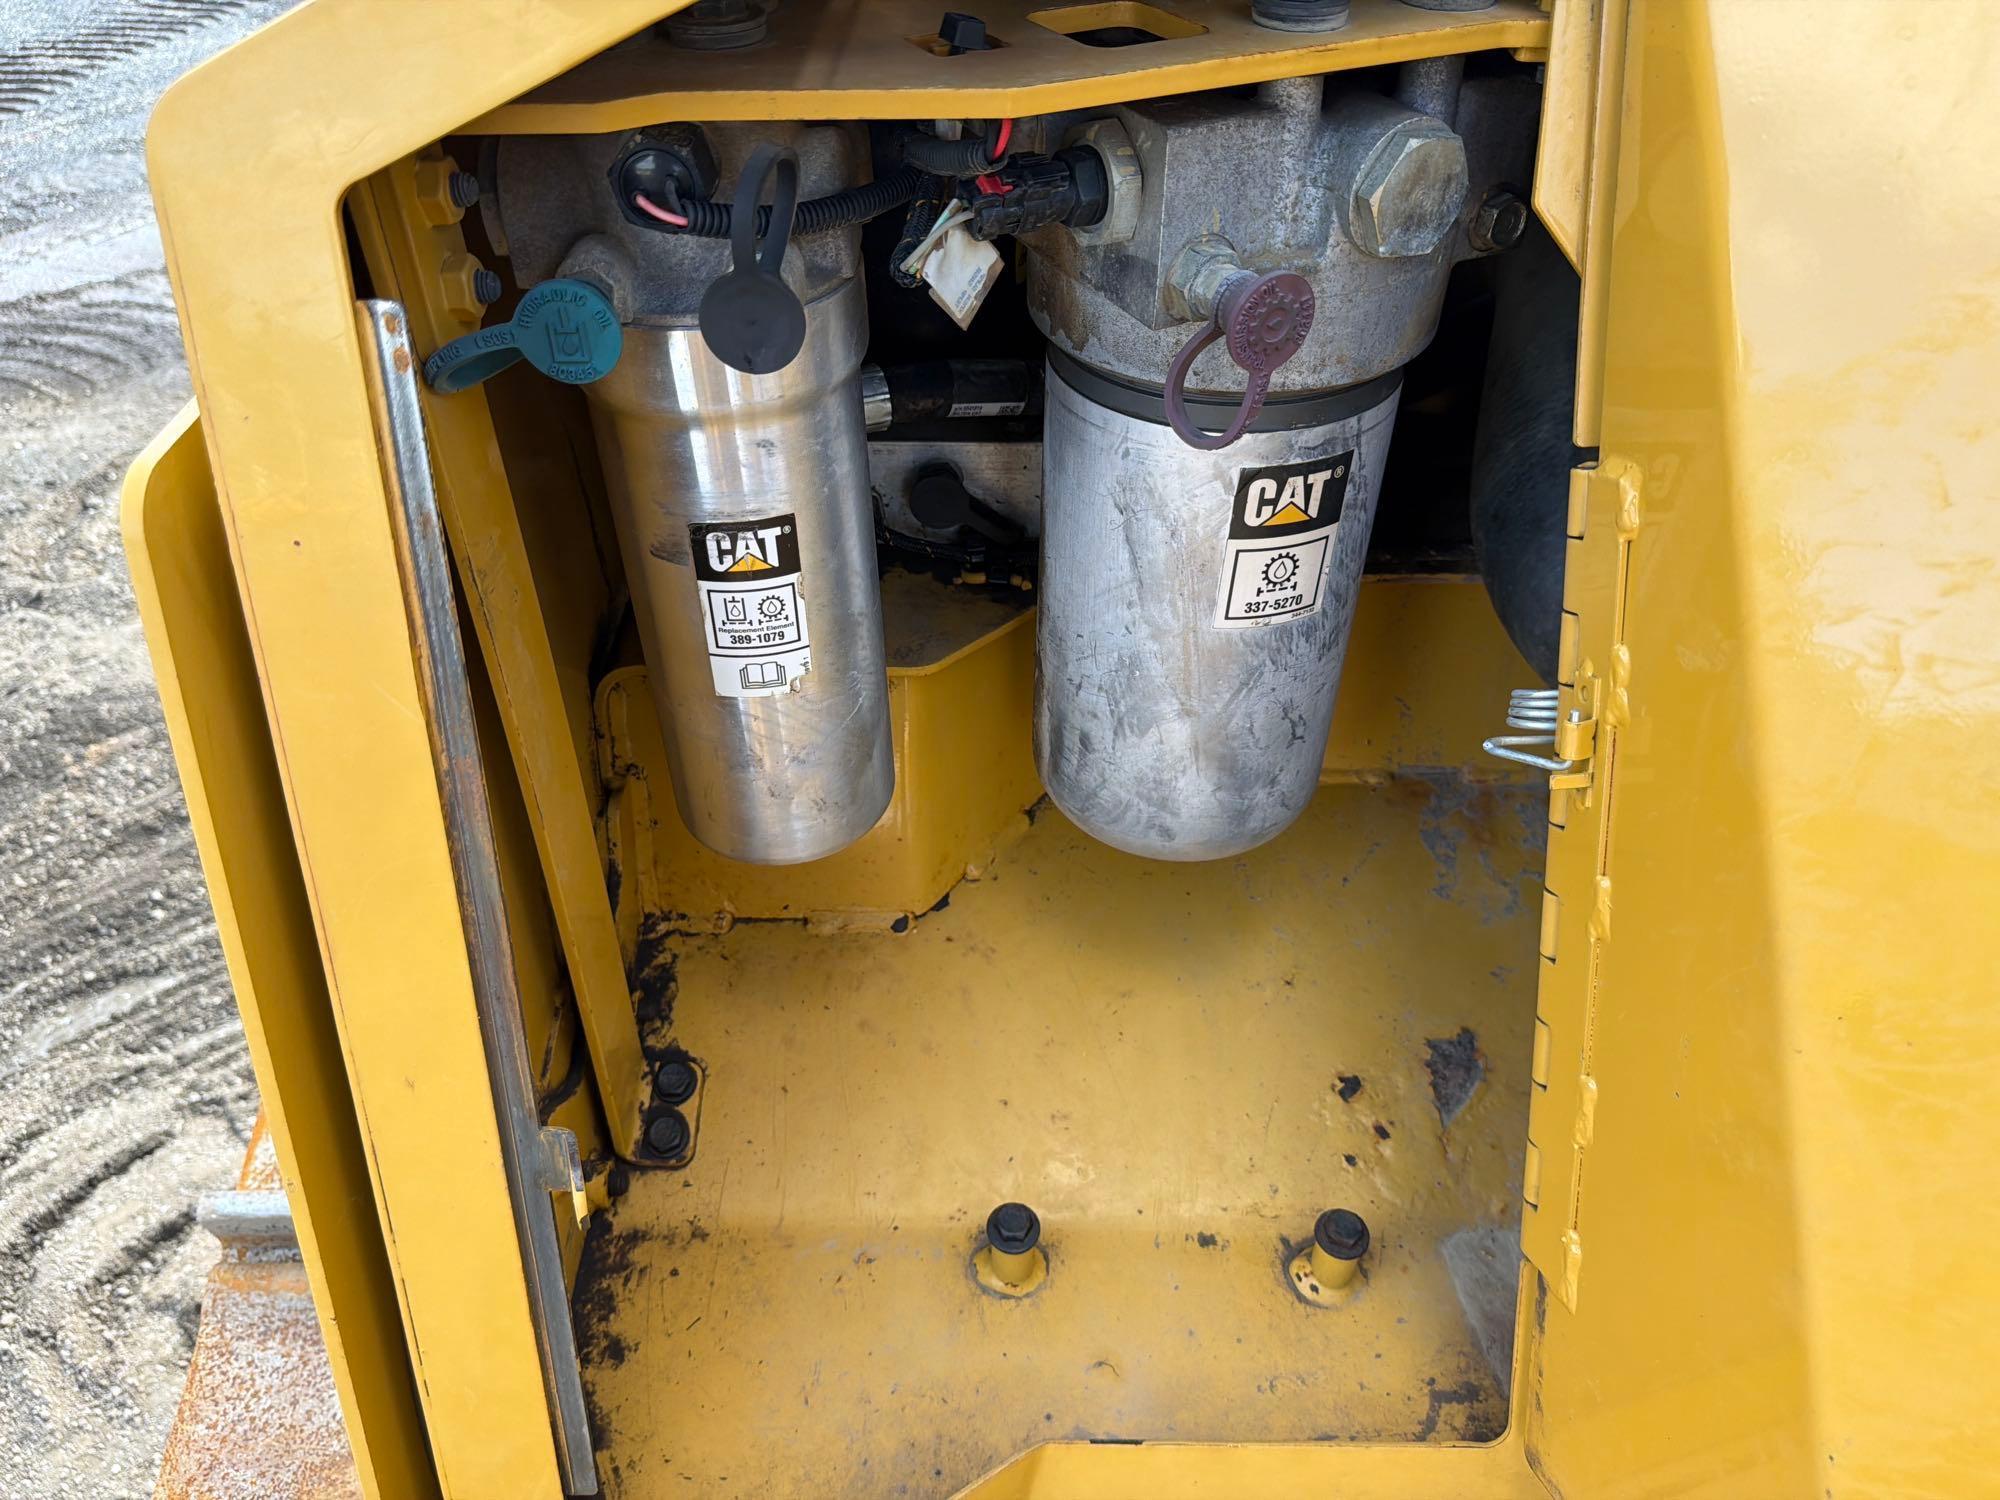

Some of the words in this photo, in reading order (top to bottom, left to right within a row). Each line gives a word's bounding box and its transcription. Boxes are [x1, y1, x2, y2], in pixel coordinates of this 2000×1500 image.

[593, 309, 614, 333] OIL
[475, 330, 514, 349] (SOS)
[1243, 593, 1304, 614] 337-5270
[718, 626, 765, 635] Replacement
[766, 620, 795, 633] Element
[730, 630, 786, 645] 389-1079
